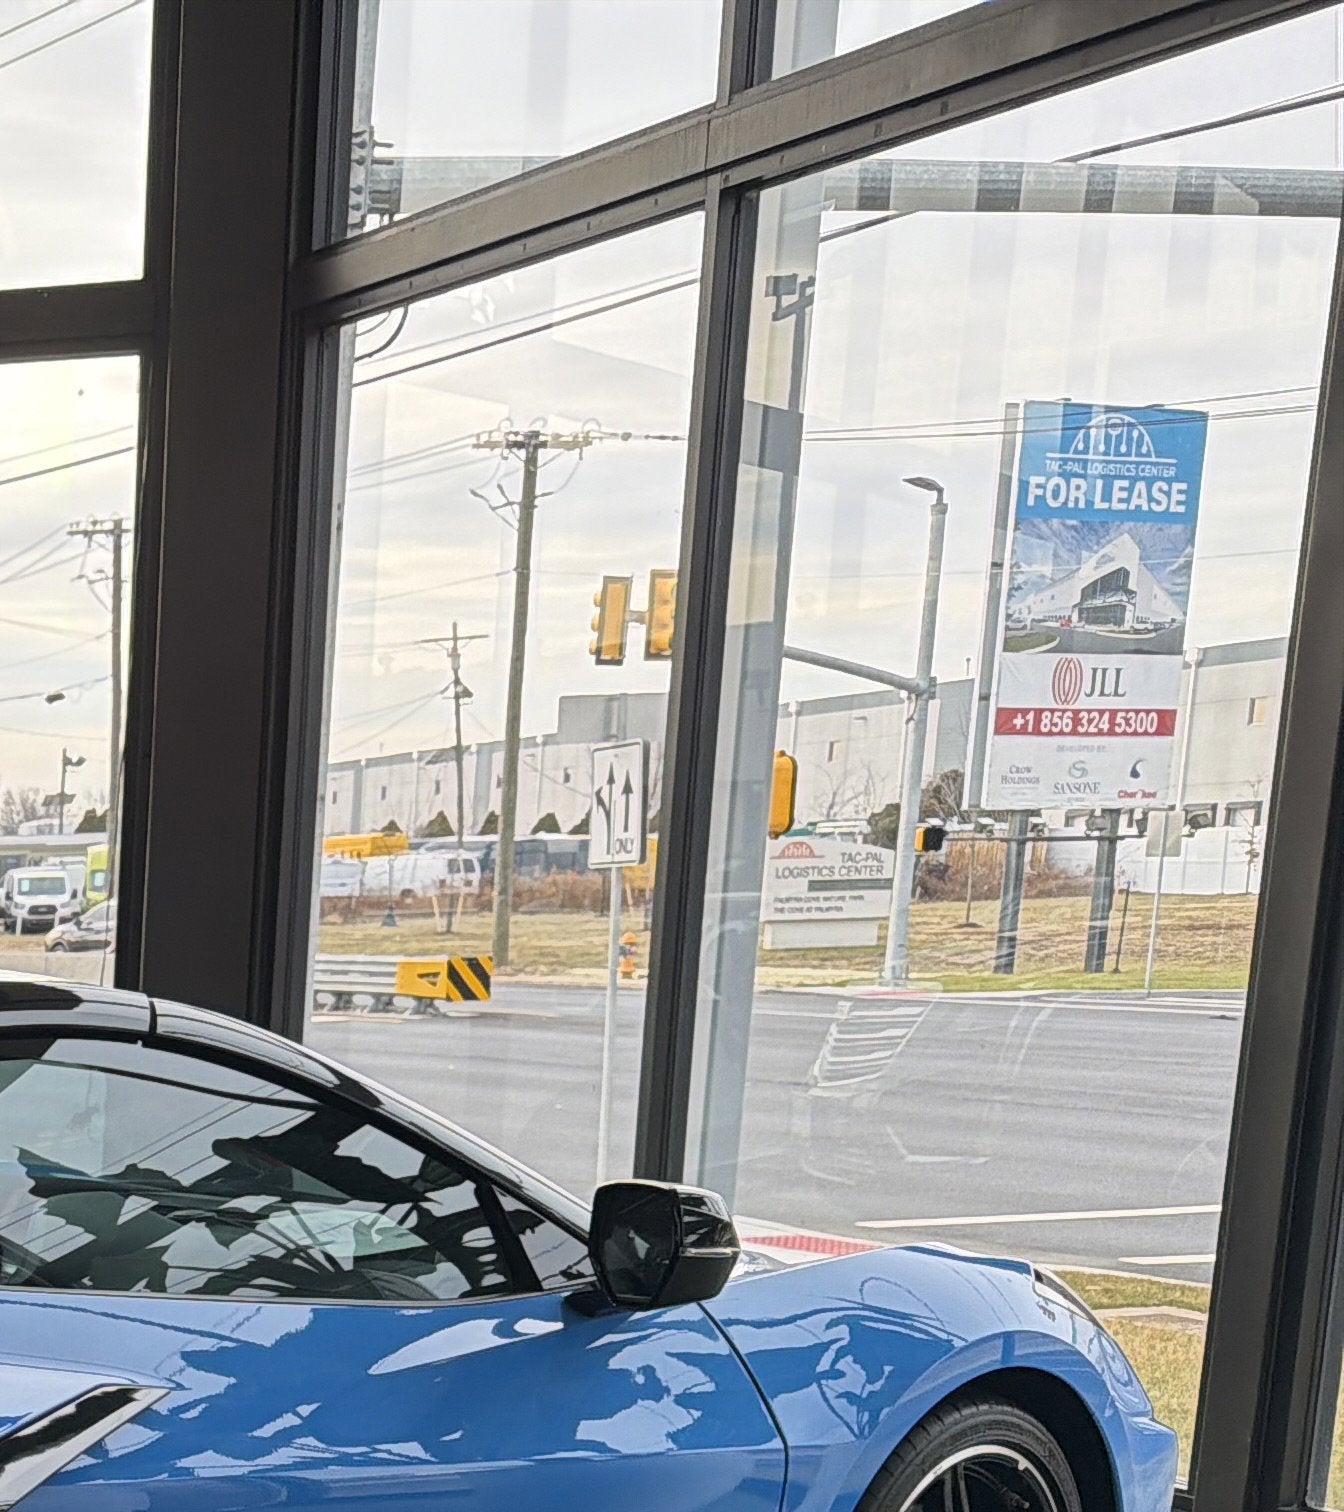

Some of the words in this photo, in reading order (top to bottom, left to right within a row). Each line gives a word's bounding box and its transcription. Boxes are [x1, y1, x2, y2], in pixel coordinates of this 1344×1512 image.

[1045, 459, 1085, 474] TAC-PAL
[1087, 462, 1136, 476] LOGISTICS
[1138, 464, 1177, 478] CENTER
[1026, 475, 1088, 509] FOR
[1093, 479, 1188, 513] LEASE
[1084, 667, 1127, 698] JLL
[1012, 710, 1035, 733] +1
[1039, 710, 1073, 733] 856
[1077, 711, 1110, 733] 324
[1114, 711, 1158, 733] 5300
[614, 837, 635, 855] ONLY
[840, 851, 885, 864] TAC-PAL
[775, 866, 836, 879] LOGISTICS
[838, 865, 884, 877] CENTER
